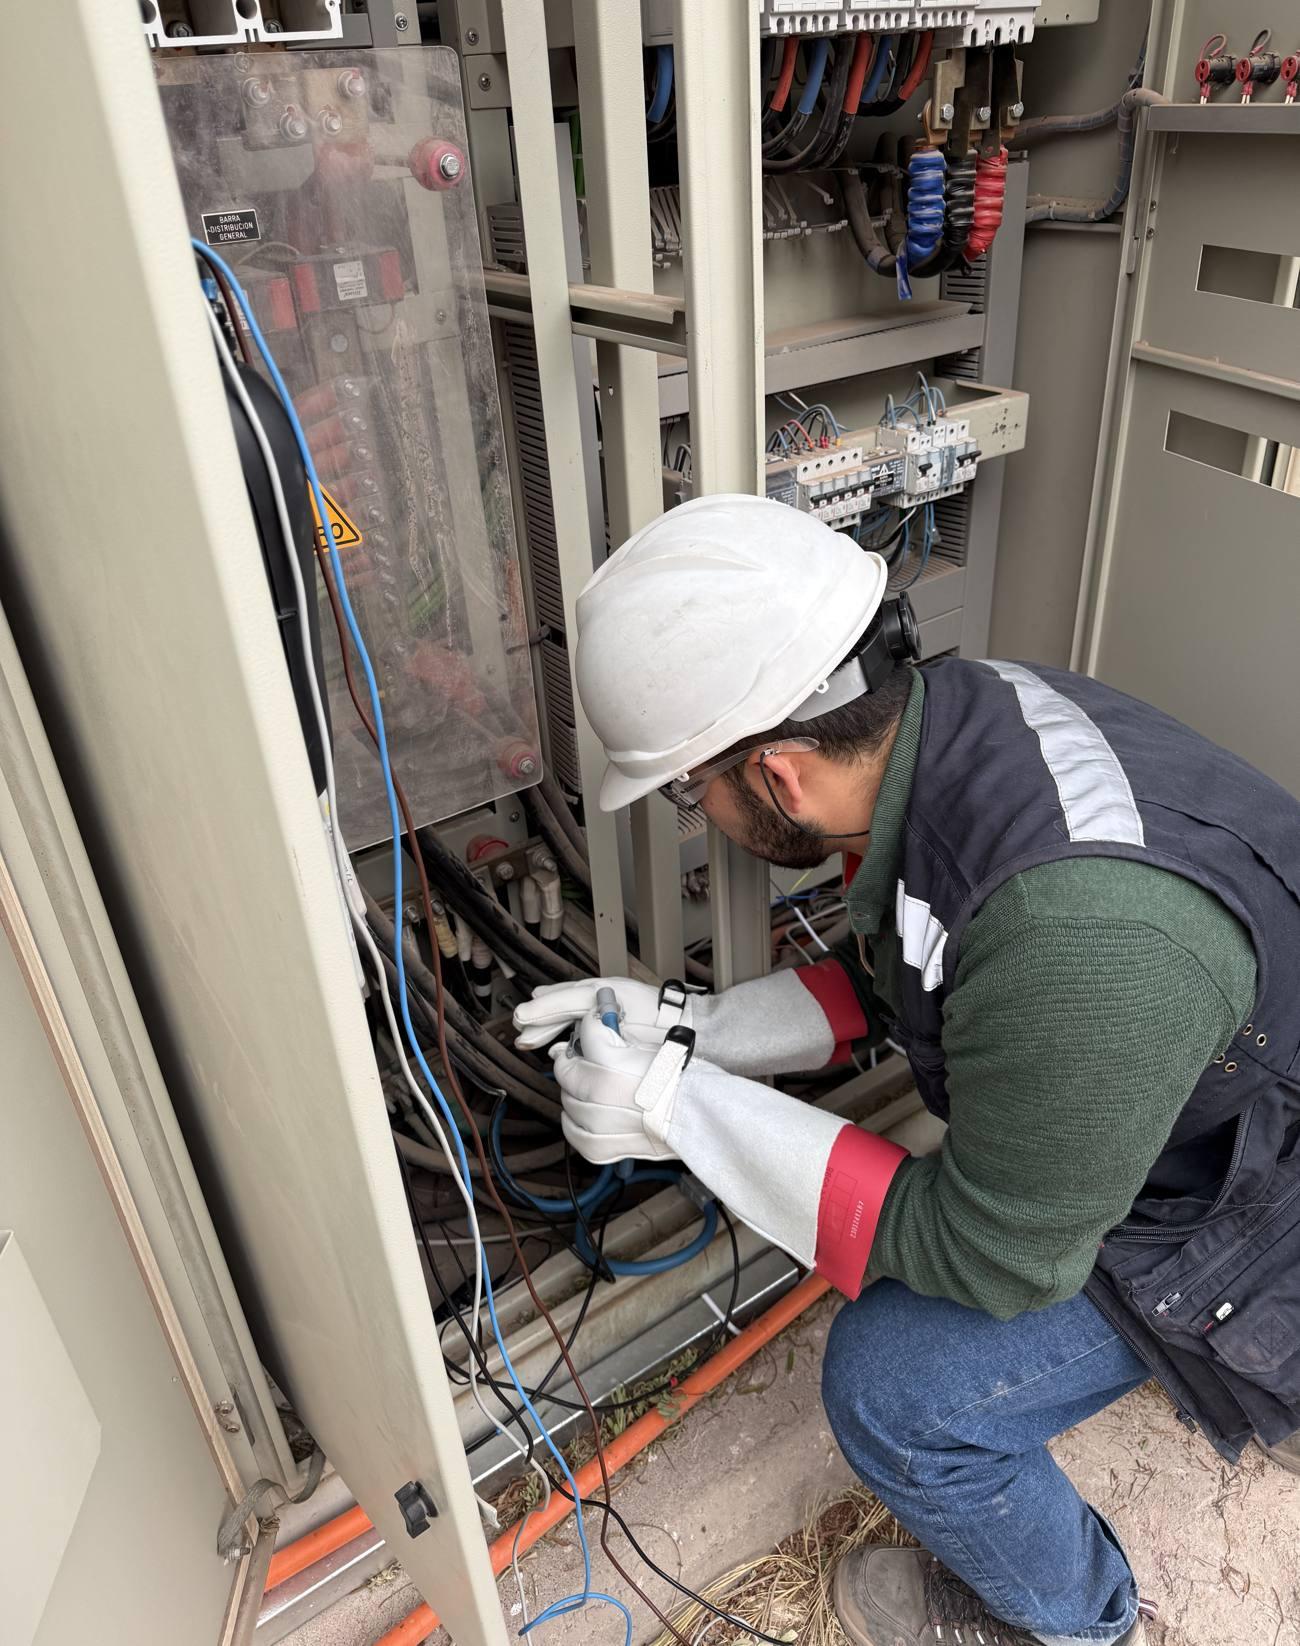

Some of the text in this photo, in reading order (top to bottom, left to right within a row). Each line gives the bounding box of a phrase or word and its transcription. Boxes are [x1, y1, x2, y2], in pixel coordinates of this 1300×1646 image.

[219, 215, 240, 223] BARRA
[209, 222, 254, 234] DISTRIBUCION
[219, 231, 247, 241] GENERAL
